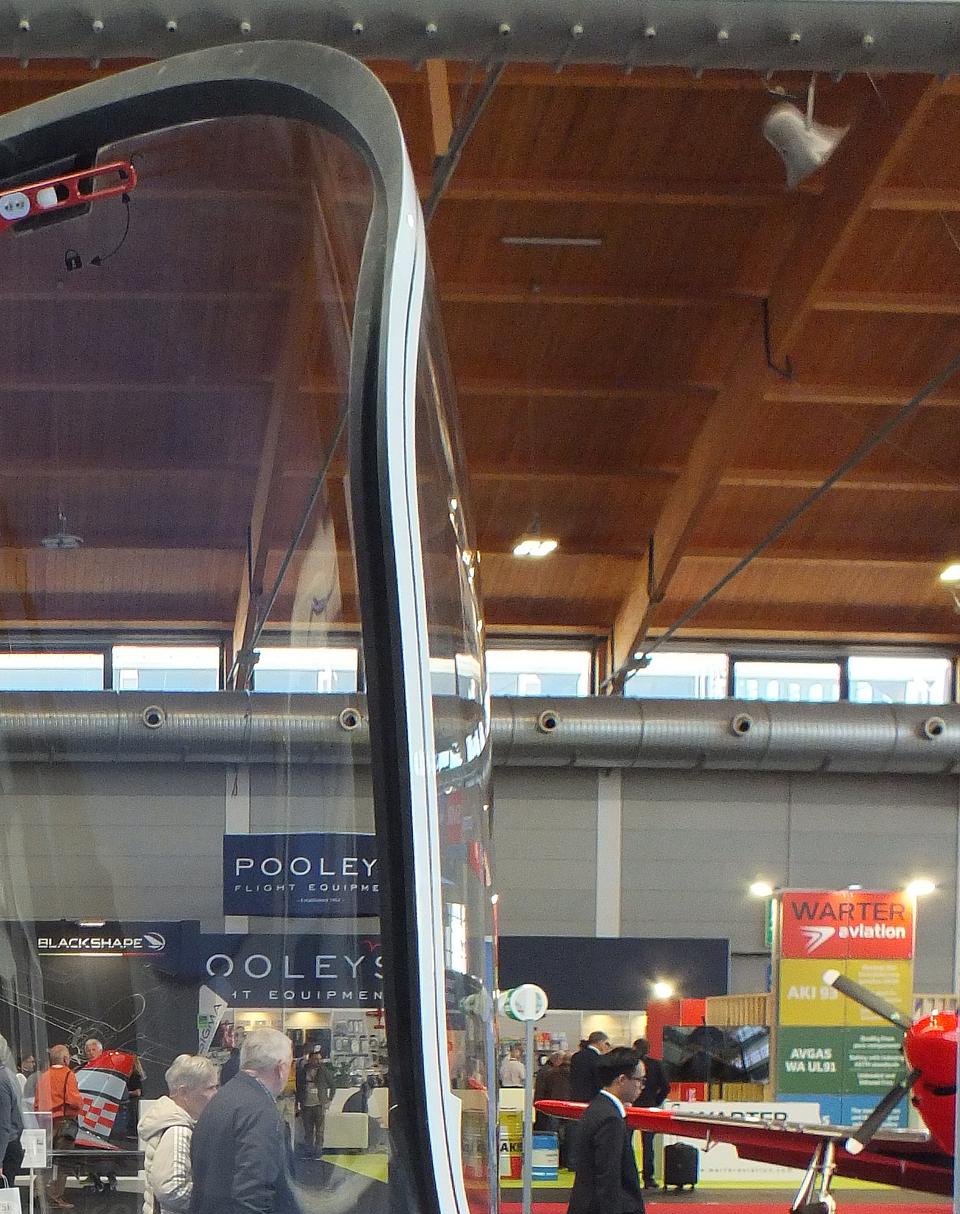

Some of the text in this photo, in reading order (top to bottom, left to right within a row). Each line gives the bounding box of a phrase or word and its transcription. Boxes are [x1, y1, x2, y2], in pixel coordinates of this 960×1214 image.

[235, 857, 379, 877] POOLEY
[234, 883, 381, 892] FLIGHT EQUIPME
[791, 902, 906, 921] WARTER
[838, 923, 906, 939] aviation
[37, 938, 143, 949] BLACKSHAPE
[269, 990, 383, 1000] EQUIPMEN
[787, 986, 816, 1000] AKI
[791, 1048, 833, 1060] AVGAS
[785, 1061, 837, 1072] WA UL91
